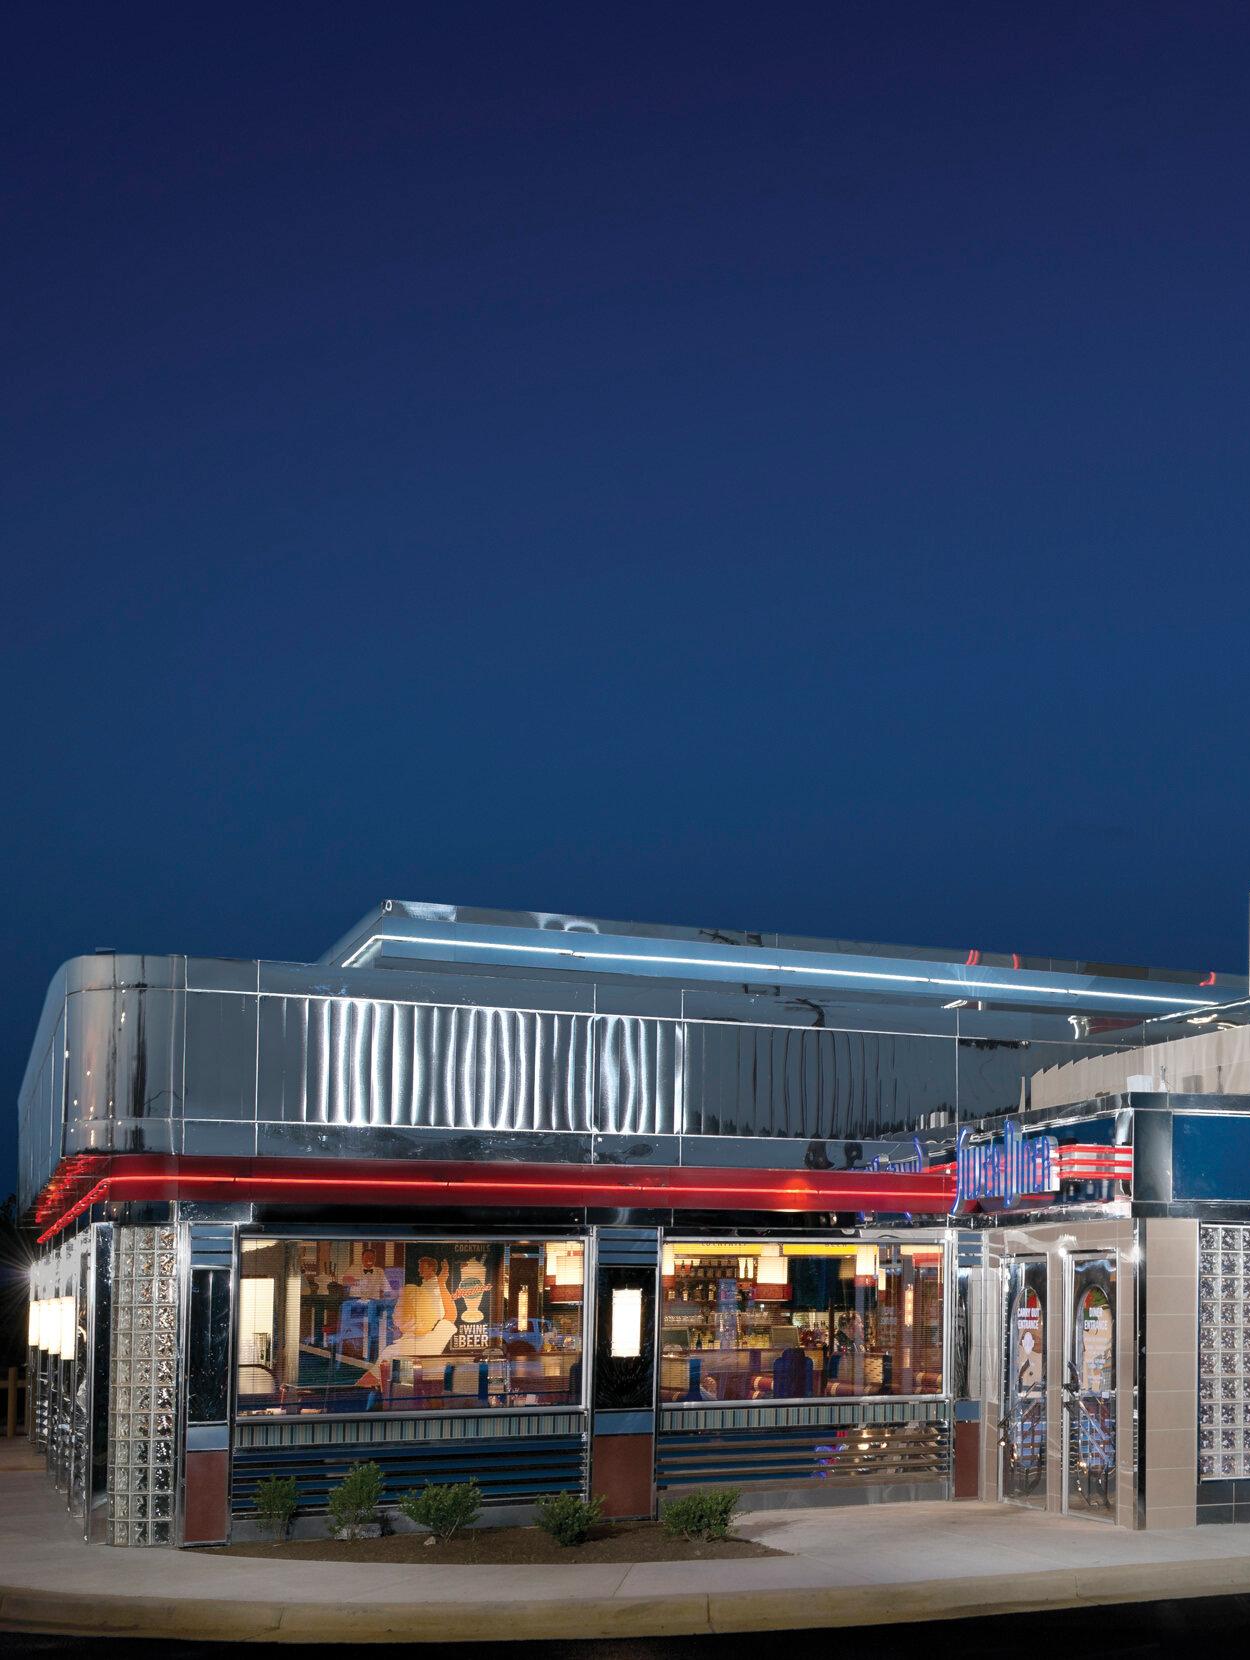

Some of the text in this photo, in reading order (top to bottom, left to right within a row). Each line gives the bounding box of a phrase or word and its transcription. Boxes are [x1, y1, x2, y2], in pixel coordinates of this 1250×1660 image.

[454, 1244, 490, 1252] COCKTAILS
[463, 1324, 488, 1335] WINE
[459, 1335, 488, 1348] BEER
